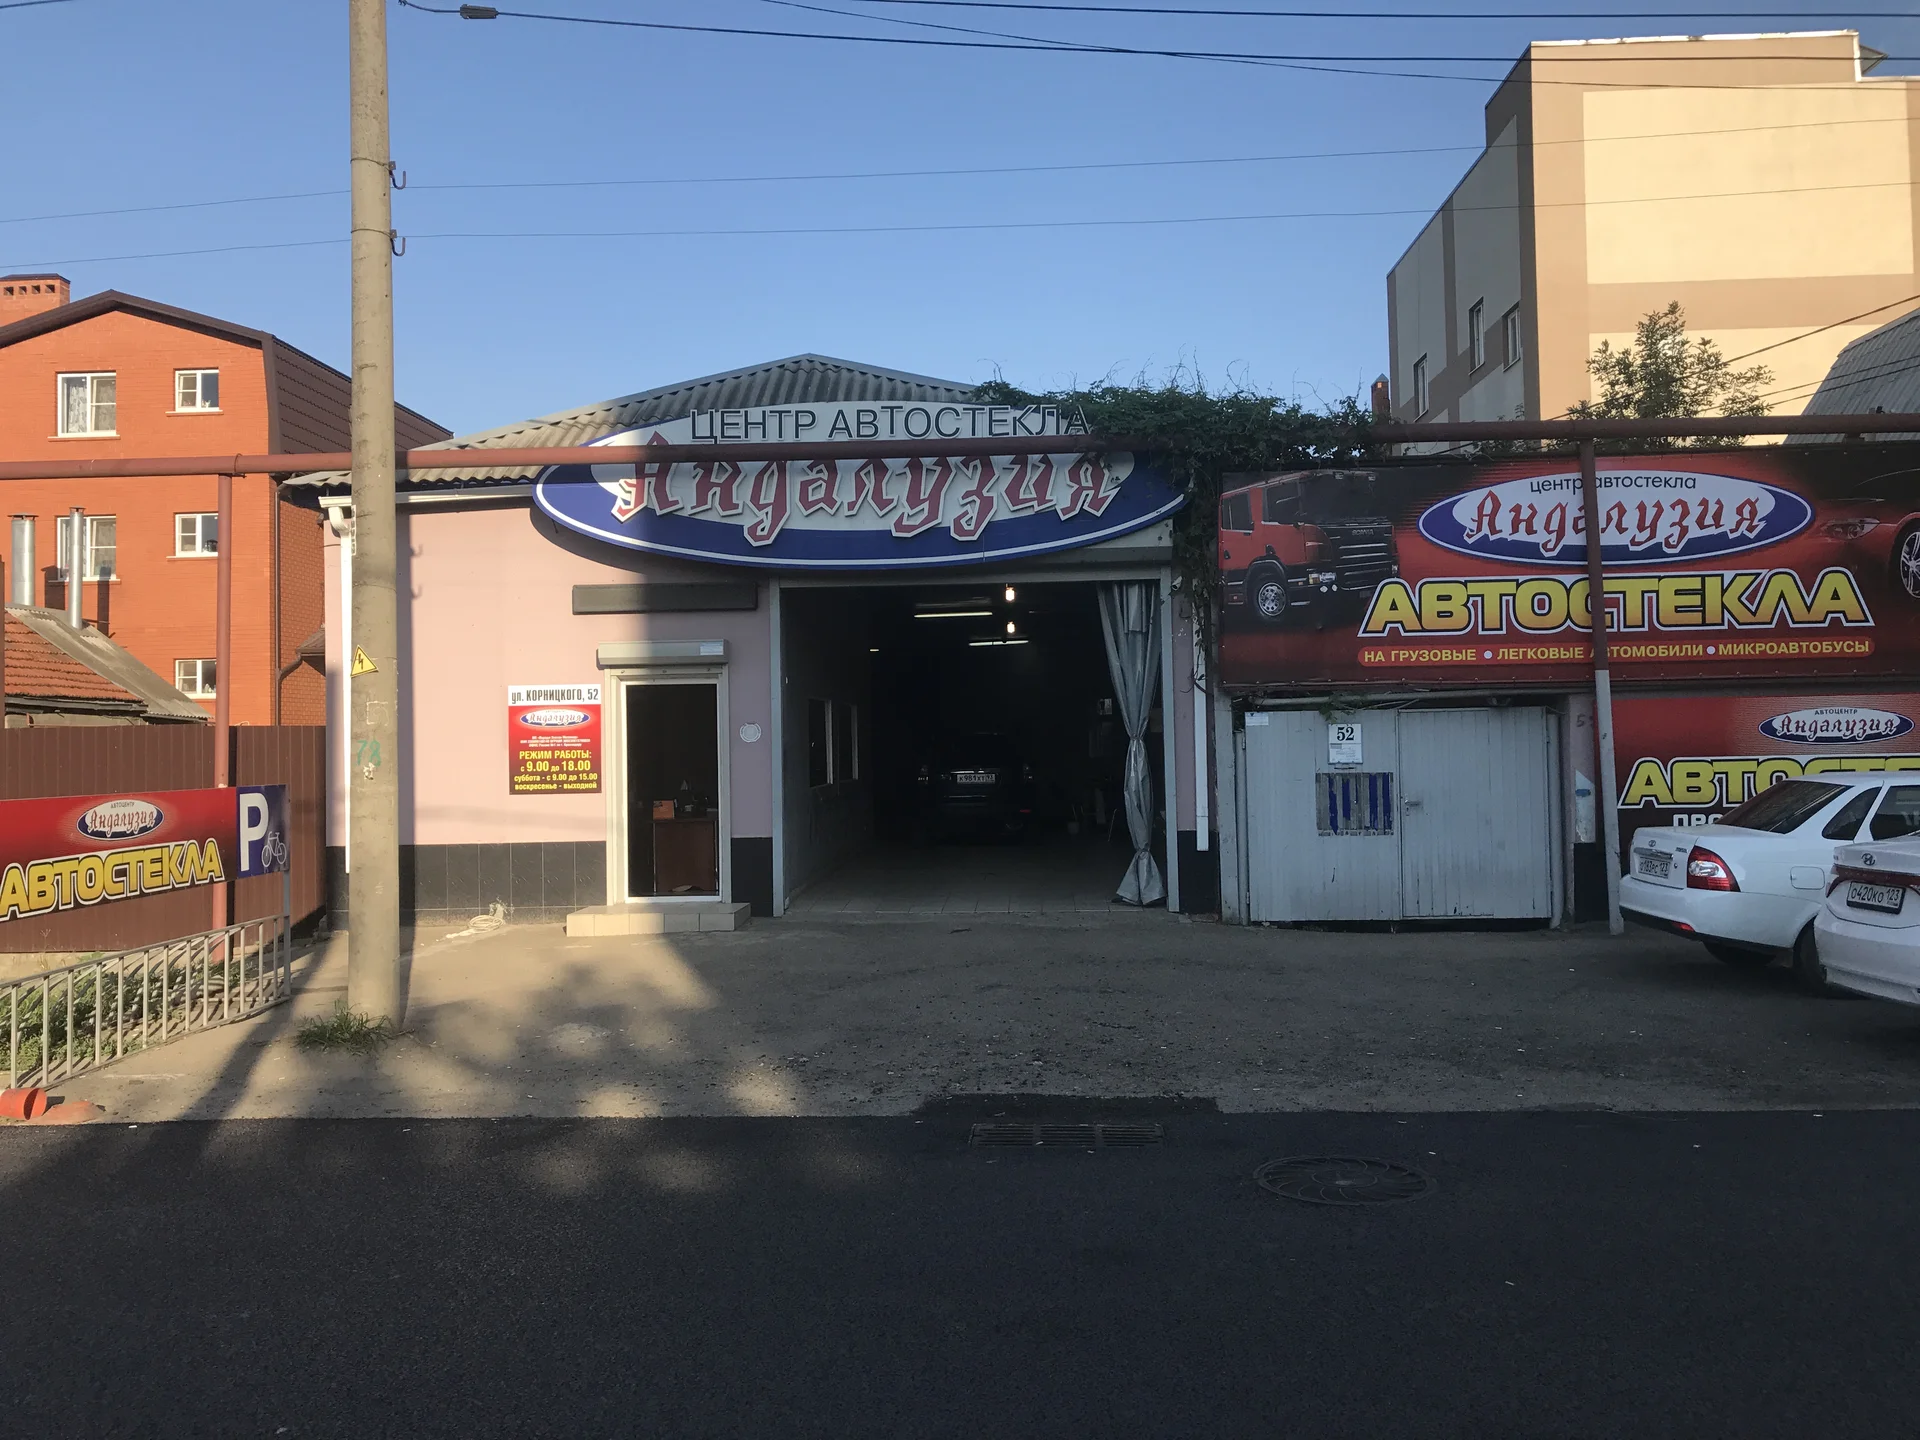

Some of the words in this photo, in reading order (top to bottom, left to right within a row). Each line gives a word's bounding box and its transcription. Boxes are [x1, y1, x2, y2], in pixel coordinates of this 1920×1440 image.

[689, 409, 816, 445] ЦЕНТР
[827, 404, 1092, 440] АВТОСТЕКЛА
[612, 431, 1119, 547] Андалузия
[1530, 478, 1584, 495] центр
[1359, 567, 1873, 636] АВТОСТЕКЛА
[1363, 651, 1385, 662] НА
[1390, 648, 1477, 661] ГРУЗОВЫЕ
[1496, 646, 1585, 660] ЛЕГКОВЫЕ
[1589, 644, 1704, 659] ТОМОБИЛИ
[1718, 640, 1870, 656] МИКРОАВТОБУСЫ
[511, 691, 524, 705] ул.
[526, 689, 585, 702] КОРНИЦКОГО,
[587, 688, 599, 701] 52
[1814, 708, 1858, 716] АВТОЦЕНТР
[1336, 726, 1355, 742] 52
[1779, 715, 1900, 739] Андалузия
[519, 750, 552, 760] РЕЖИМ
[554, 750, 592, 759] РАБОТЫ:
[526, 760, 549, 772] 9.00
[550, 765, 560, 773] до
[561, 760, 591, 771] 18.00
[514, 774, 541, 783] суббота
[552, 773, 568, 781] 9.00
[568, 774, 578, 782] до
[579, 772, 598, 781] 15.00
[514, 783, 558, 791] воскресенье
[563, 781, 598, 790] выходной
[1619, 756, 1920, 808] АВТО
[87, 809, 155, 836] Андалузия
[239, 791, 269, 873] P
[0, 839, 223, 920] АВТОСТЕКЛА
[1885, 888, 1901, 902] 123
